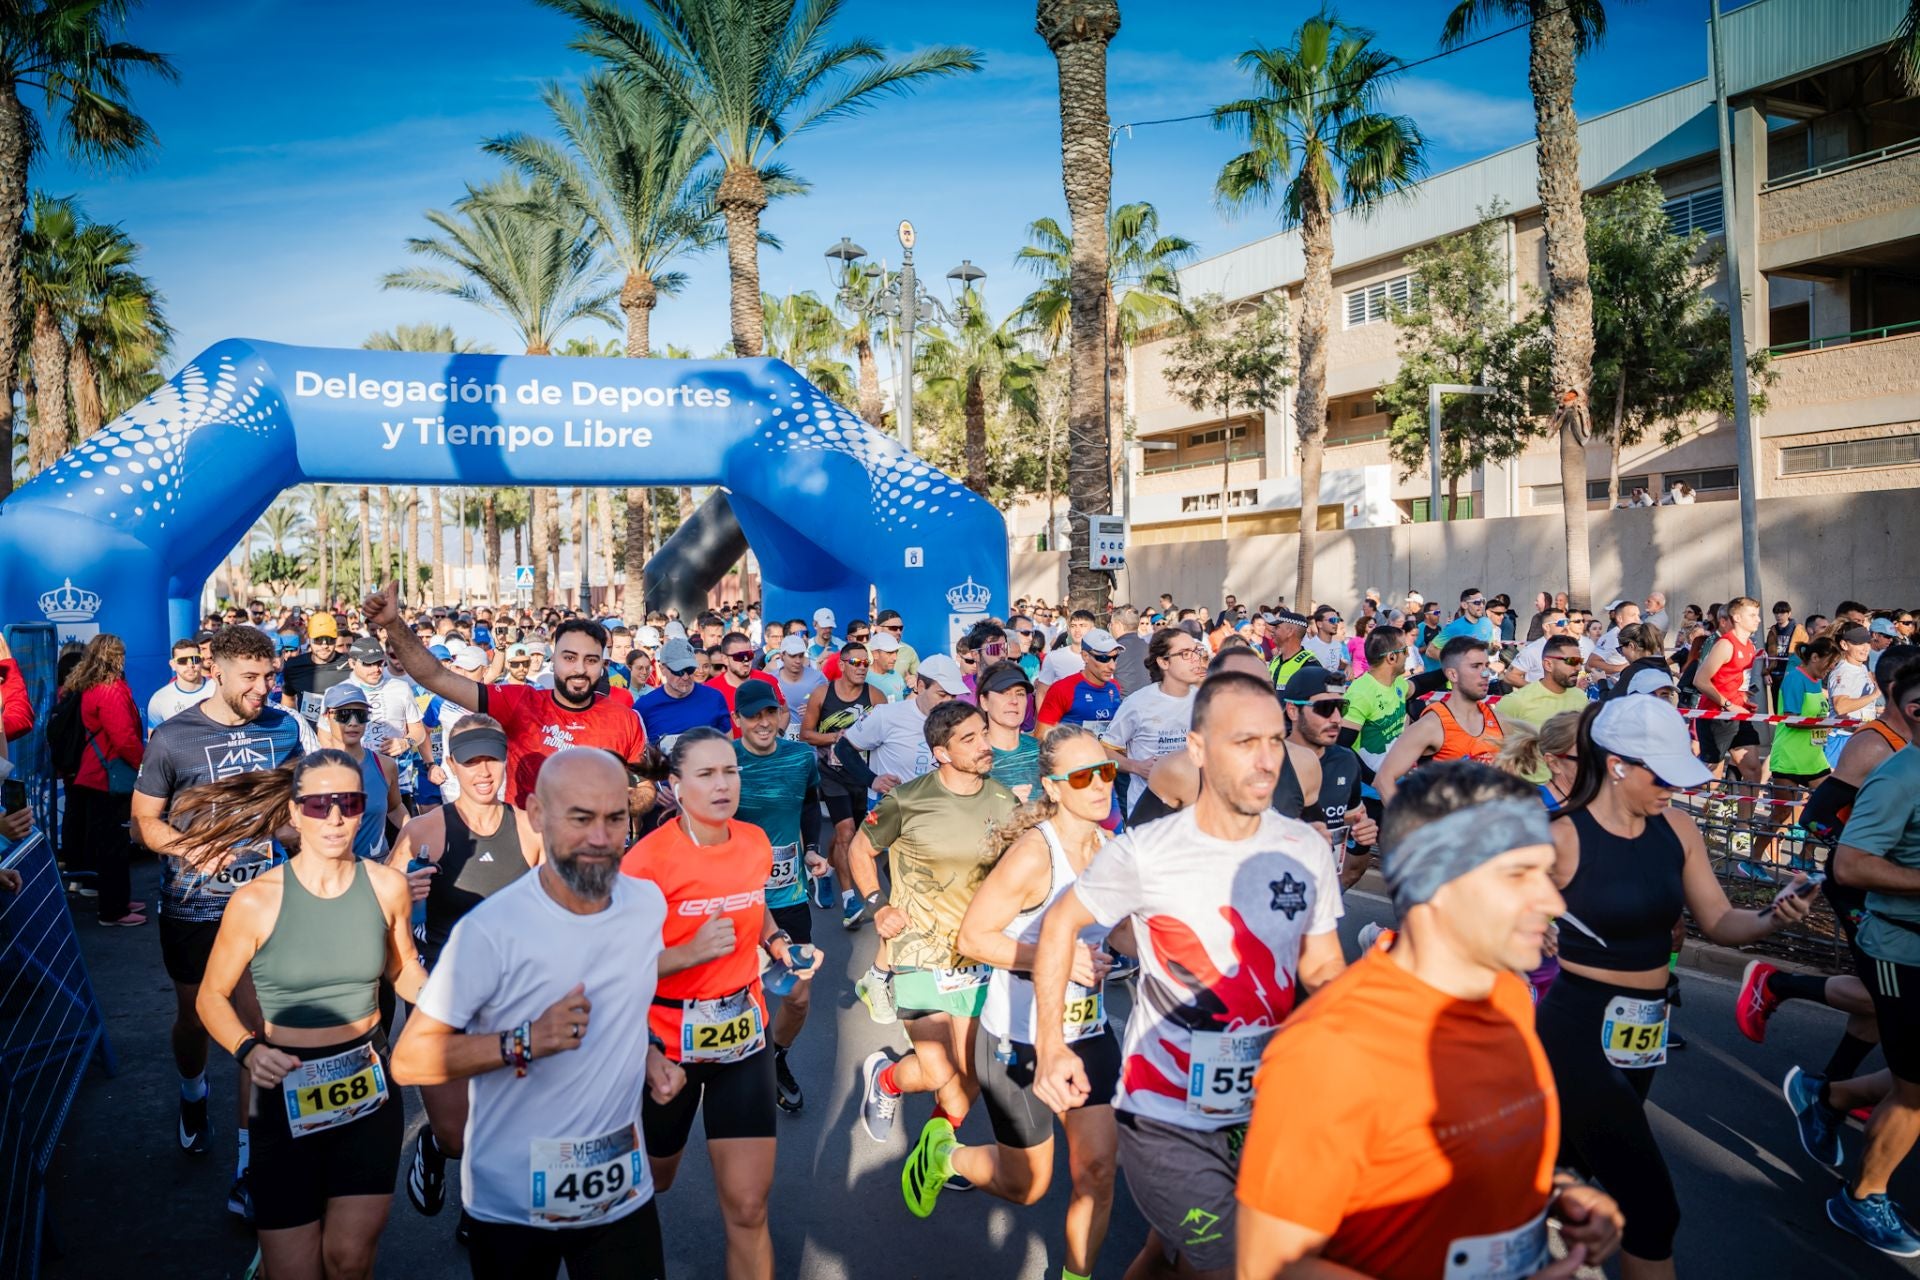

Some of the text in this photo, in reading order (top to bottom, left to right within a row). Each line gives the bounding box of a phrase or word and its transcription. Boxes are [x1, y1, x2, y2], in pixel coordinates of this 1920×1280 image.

[295, 370, 732, 415] Delegación de Deportes
[381, 417, 653, 454] y Tiempo Libre
[216, 863, 261, 884] 607
[700, 1017, 750, 1048] 248
[1619, 1025, 1661, 1050] 151
[316, 1055, 353, 1074] MEDIA
[306, 1075, 369, 1111] 168
[1211, 1065, 1256, 1095] 55
[573, 1135, 614, 1156] MEDIA
[554, 1162, 625, 1202] 469
